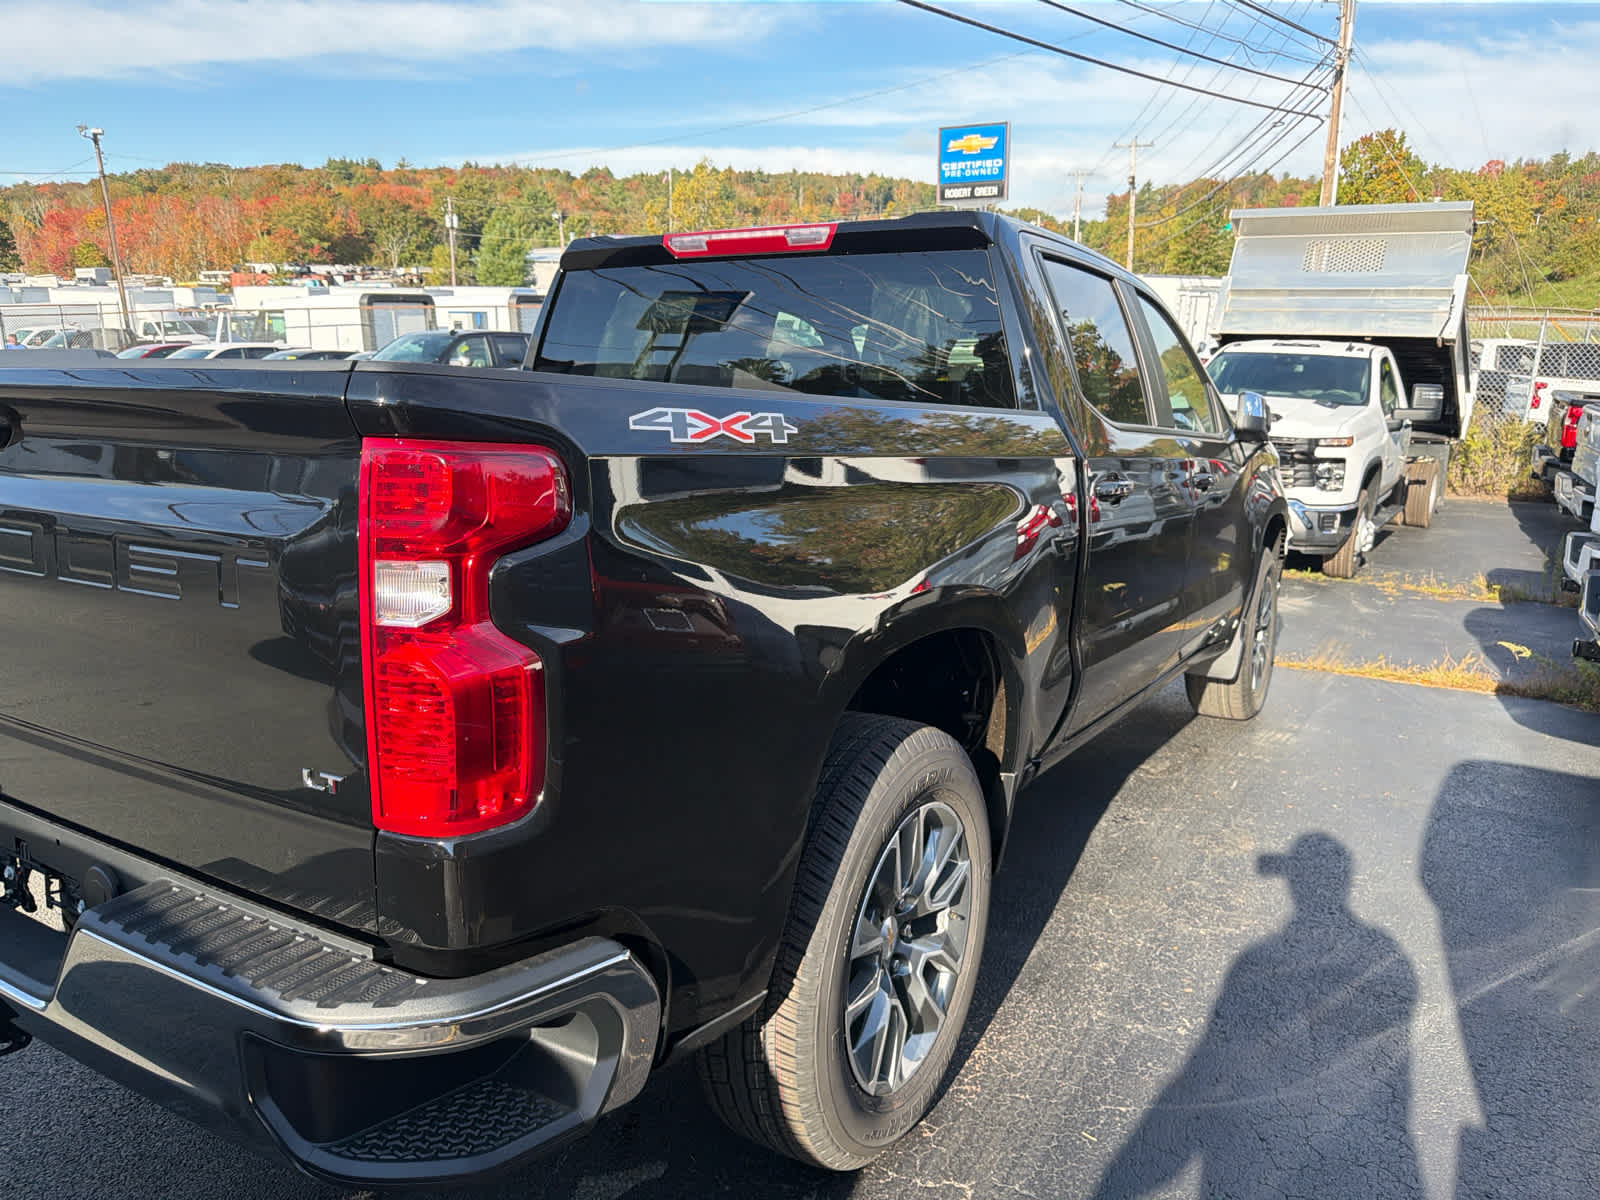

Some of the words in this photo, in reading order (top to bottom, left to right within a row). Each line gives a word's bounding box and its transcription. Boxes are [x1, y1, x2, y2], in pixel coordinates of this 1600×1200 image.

[942, 158, 1003, 171] CERTIFIED
[974, 185, 999, 197] GREEN
[302, 768, 346, 795] LT
